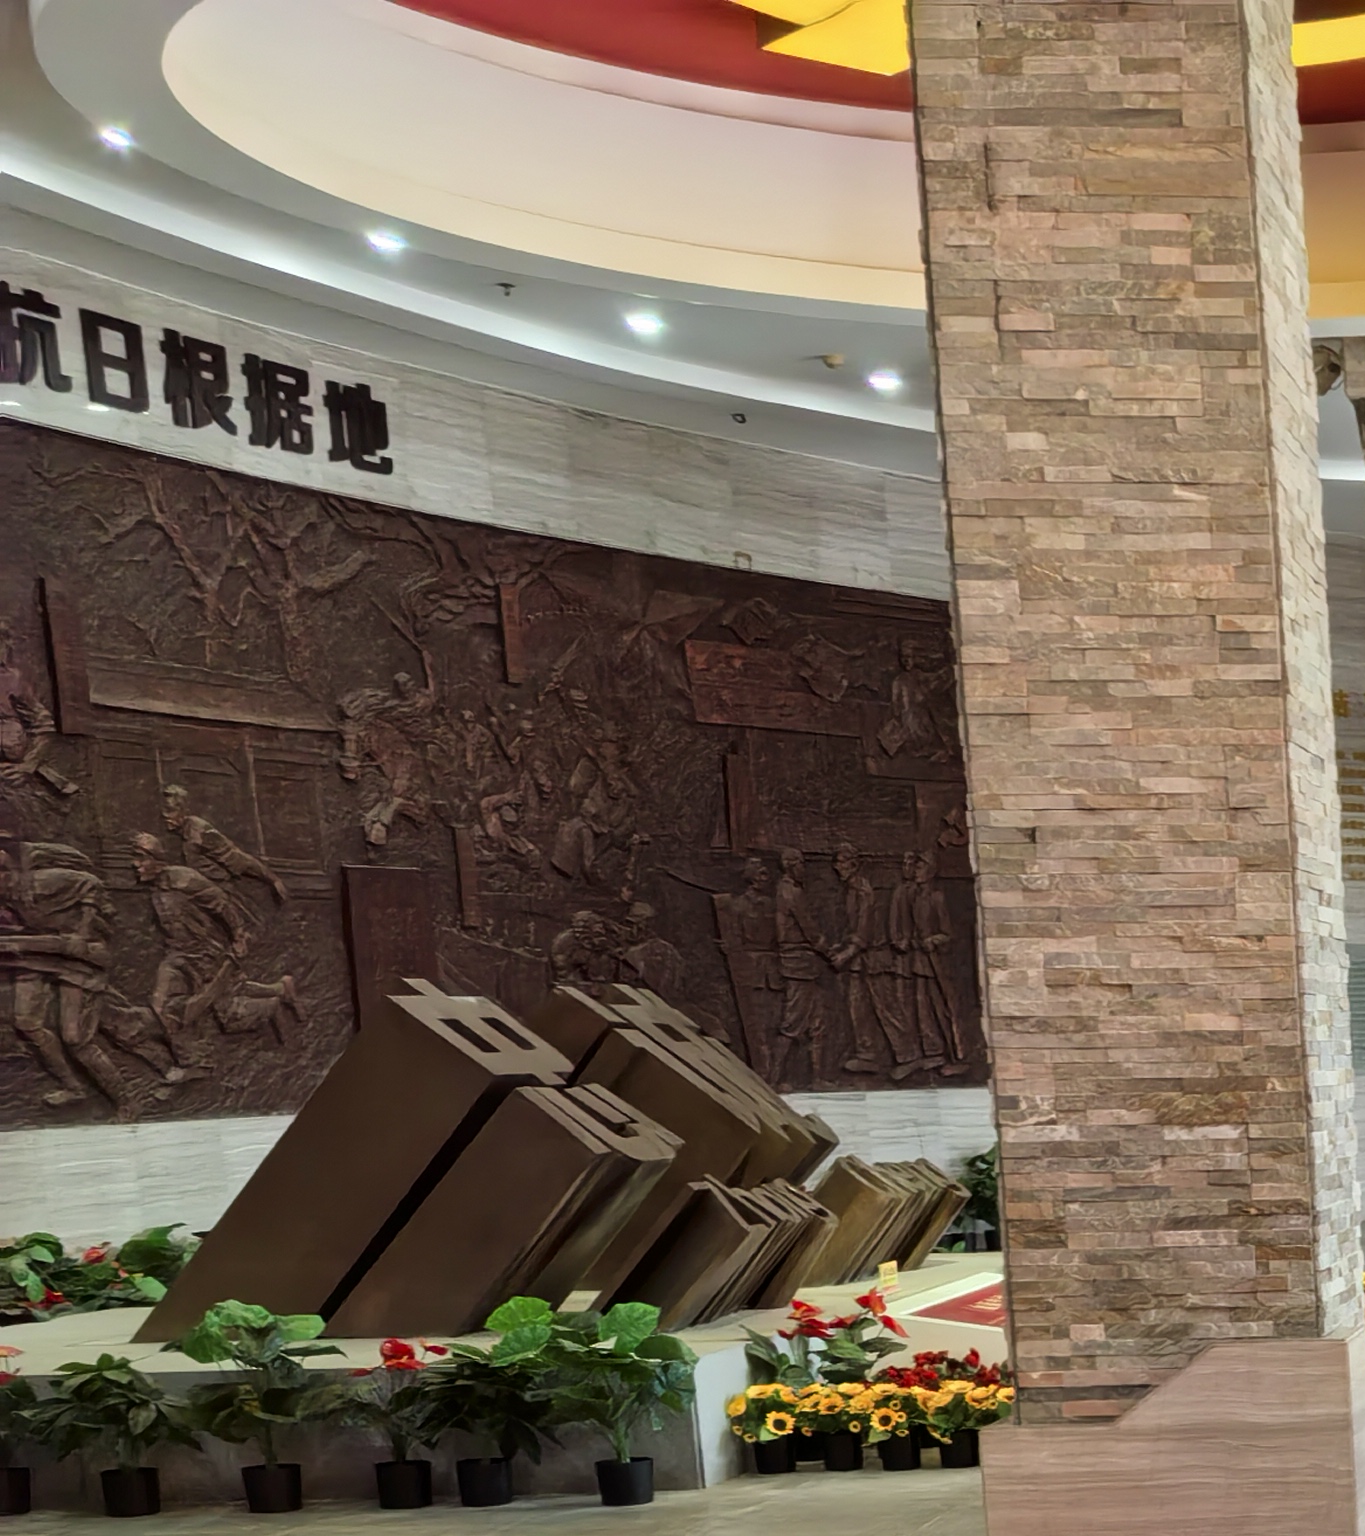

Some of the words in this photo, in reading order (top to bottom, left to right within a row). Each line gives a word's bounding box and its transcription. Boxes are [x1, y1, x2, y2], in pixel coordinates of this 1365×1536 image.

[0, 280, 394, 476] 抗日根据地
